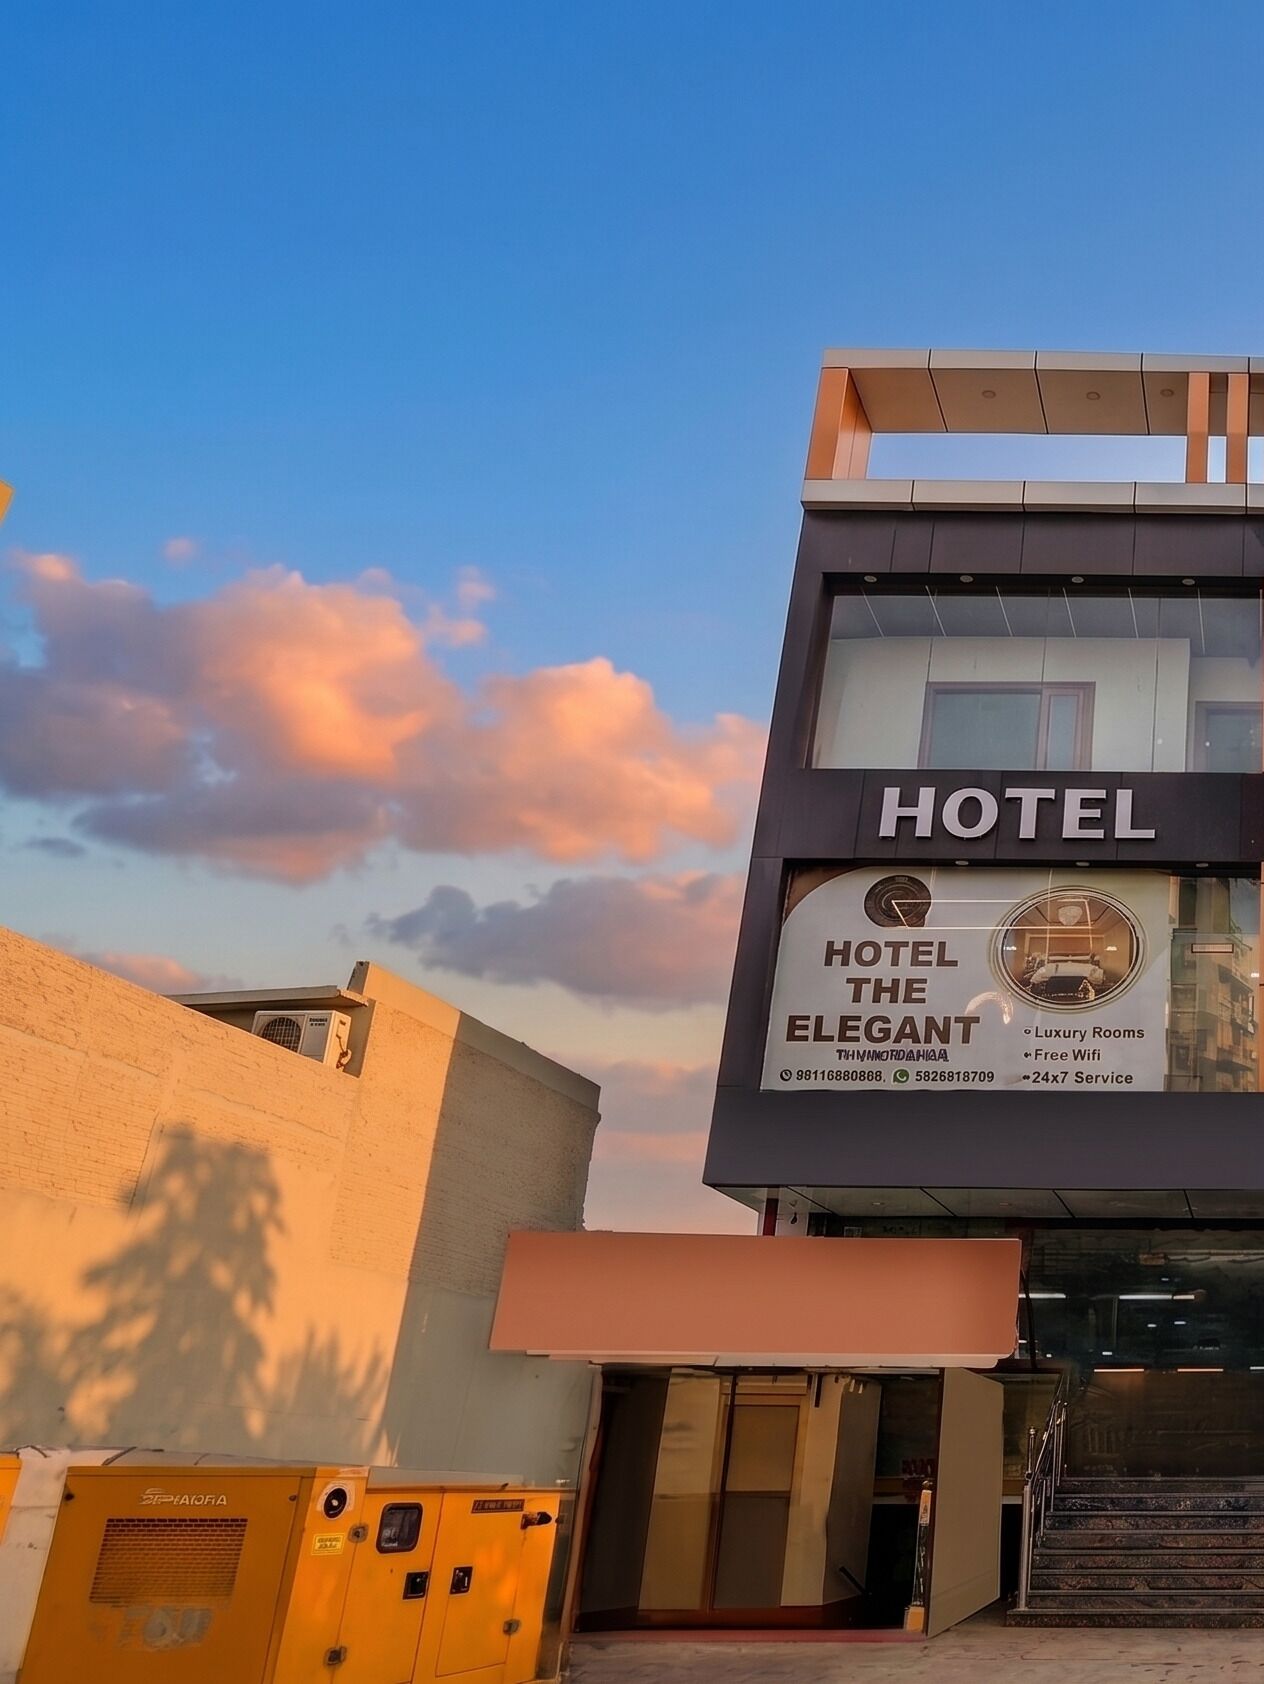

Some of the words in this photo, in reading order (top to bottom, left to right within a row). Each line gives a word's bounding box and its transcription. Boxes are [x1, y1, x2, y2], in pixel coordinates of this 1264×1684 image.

[878, 786, 1156, 840] HOTEL
[823, 940, 959, 968] HOTEL
[846, 977, 928, 1004] THE
[785, 1014, 981, 1045] ELEGANT
[1034, 1026, 1087, 1042] Luxury
[1092, 1026, 1145, 1039] Rooms
[1034, 1049, 1069, 1061] Free
[1072, 1049, 1101, 1061] Wifi
[1031, 1071, 1069, 1084] 24x7
[1074, 1071, 1134, 1084] Service
